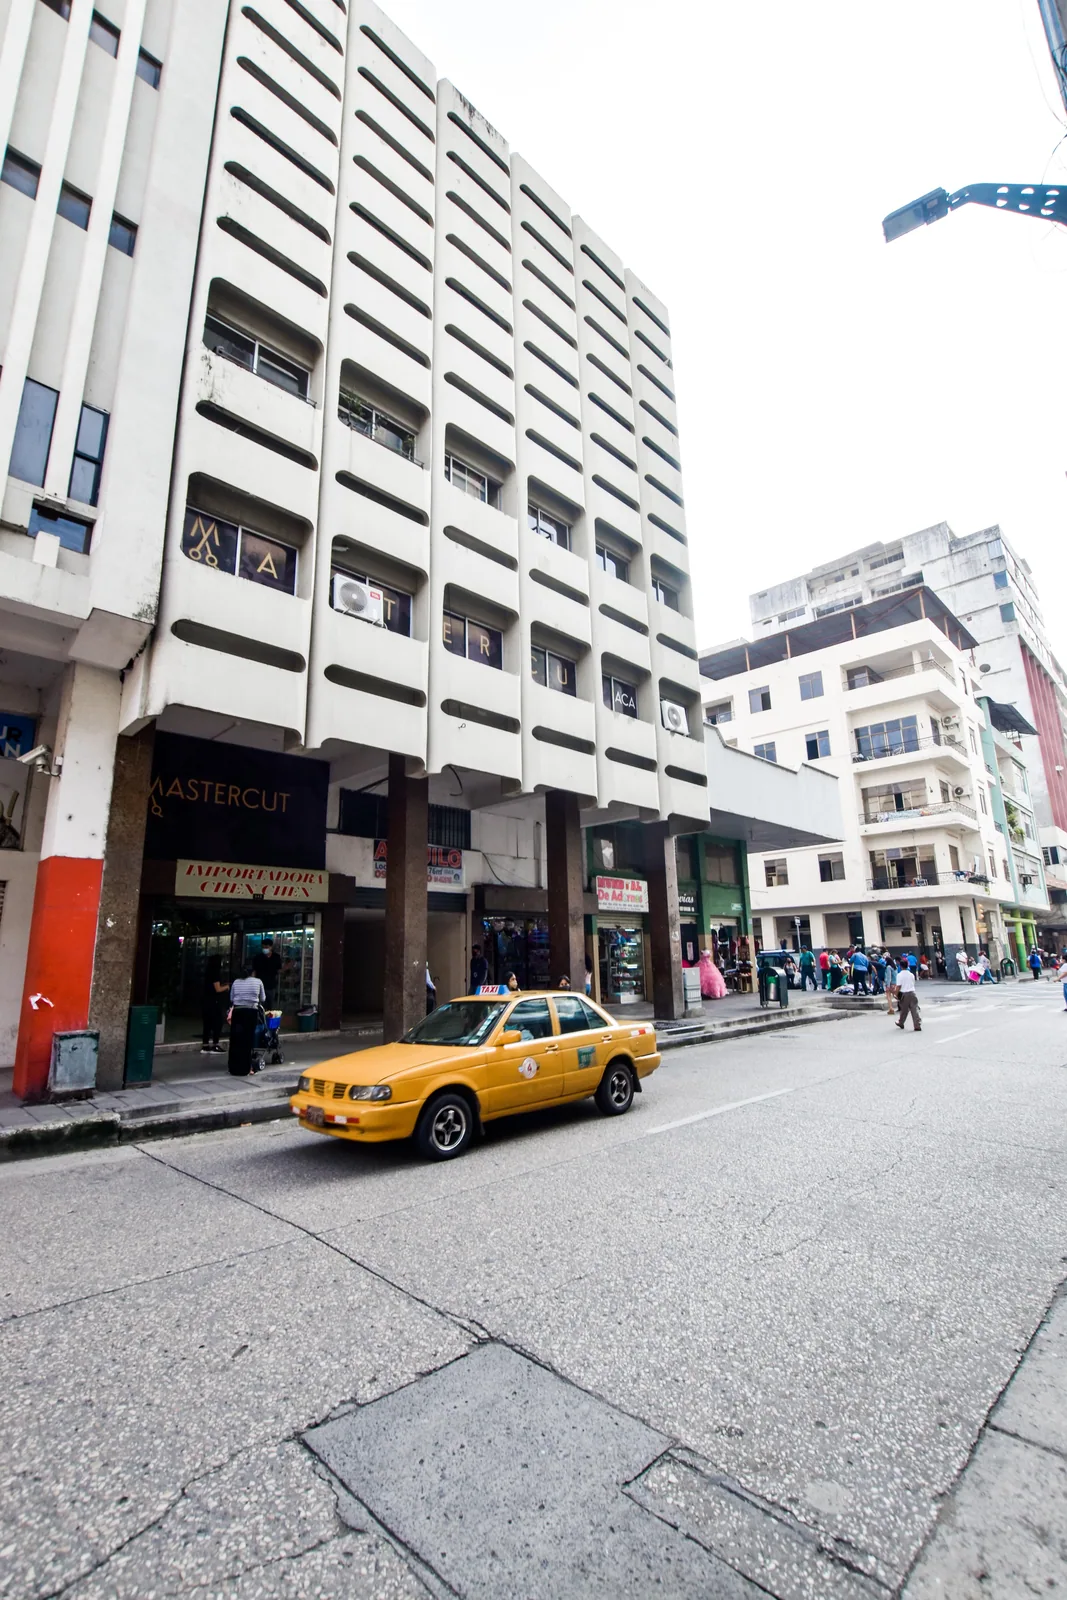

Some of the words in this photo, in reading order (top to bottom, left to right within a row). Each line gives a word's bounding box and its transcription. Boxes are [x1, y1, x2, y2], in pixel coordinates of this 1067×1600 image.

[186, 864, 323, 884] IMPORTADORA
[200, 881, 258, 895] CHEN
[261, 884, 313, 898] CHEN
